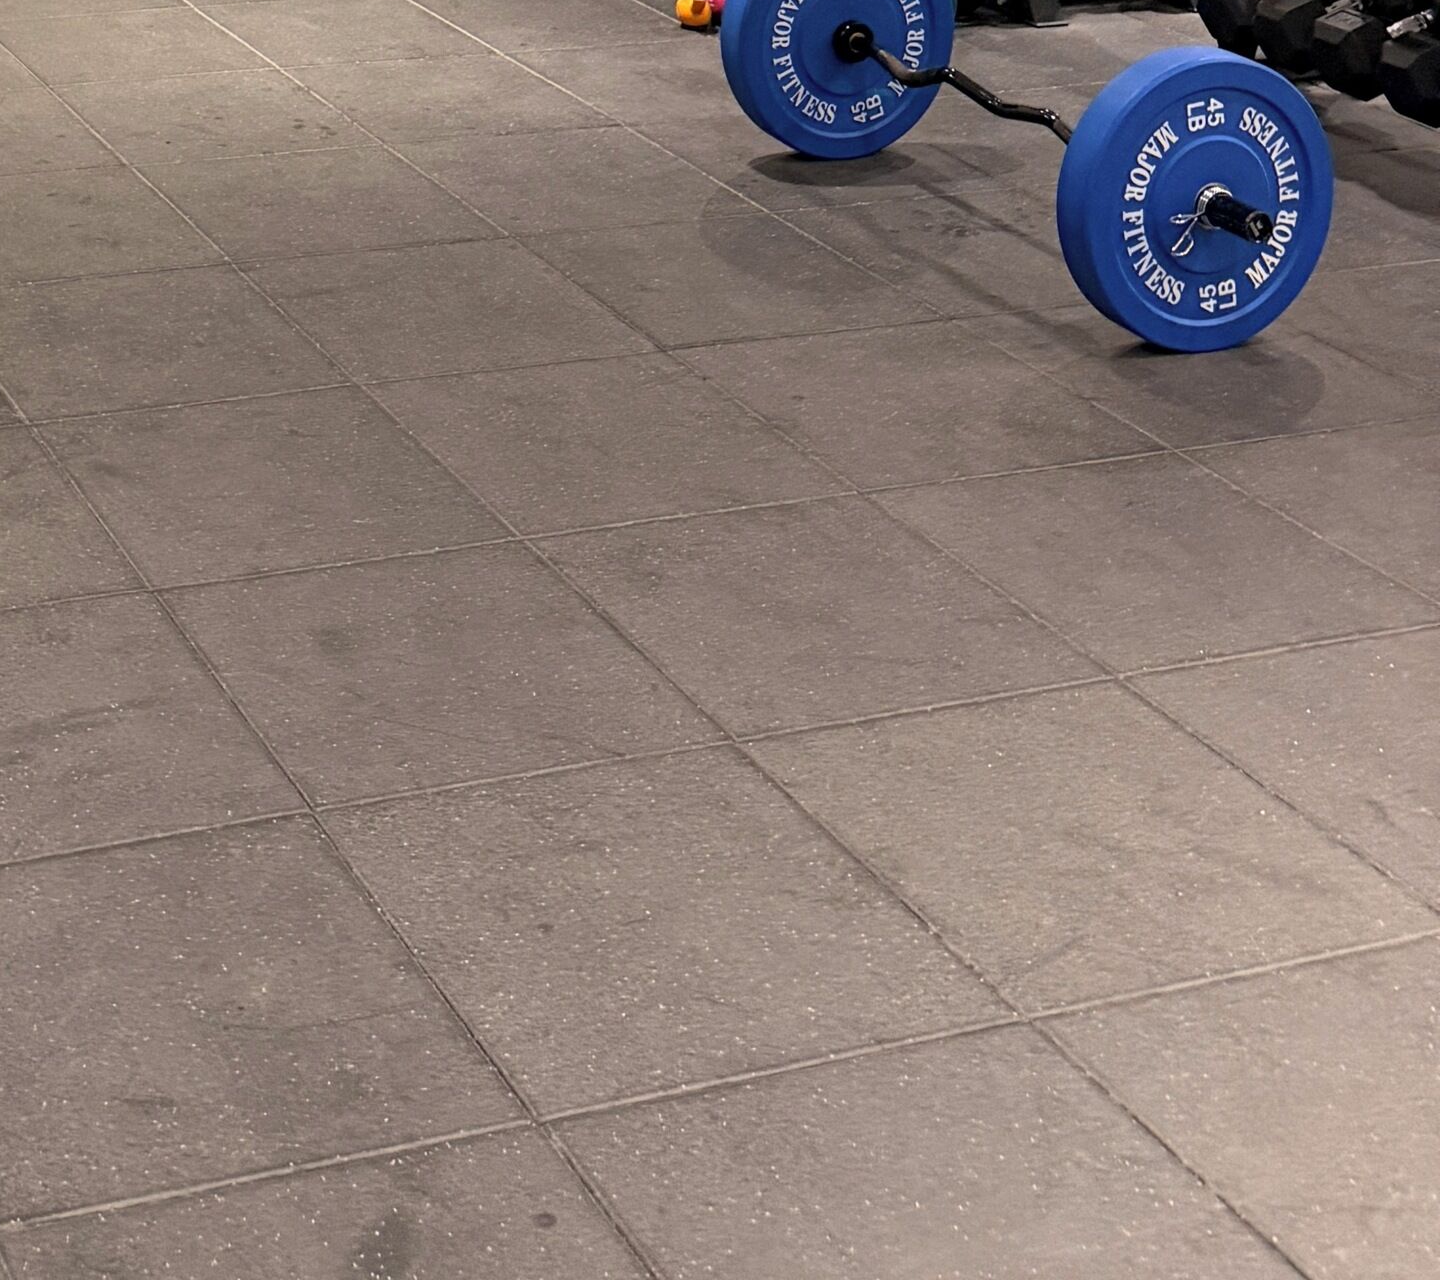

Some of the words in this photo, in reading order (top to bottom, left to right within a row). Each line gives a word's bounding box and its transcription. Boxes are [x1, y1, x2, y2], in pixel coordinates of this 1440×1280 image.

[888, 28, 925, 98] MJOR
[773, 53, 837, 125] FITNESS
[851, 101, 868, 124] 45
[865, 94, 885, 121] LB
[1206, 97, 1225, 127] 45
[1186, 101, 1207, 132] LB
[1124, 121, 1179, 202] MAJOR
[1238, 106, 1300, 203] FITNESS
[1122, 208, 1186, 306] FITNESS
[1244, 209, 1298, 290] MAJOR
[1199, 283, 1218, 313] 45
[1217, 278, 1238, 310] LB
